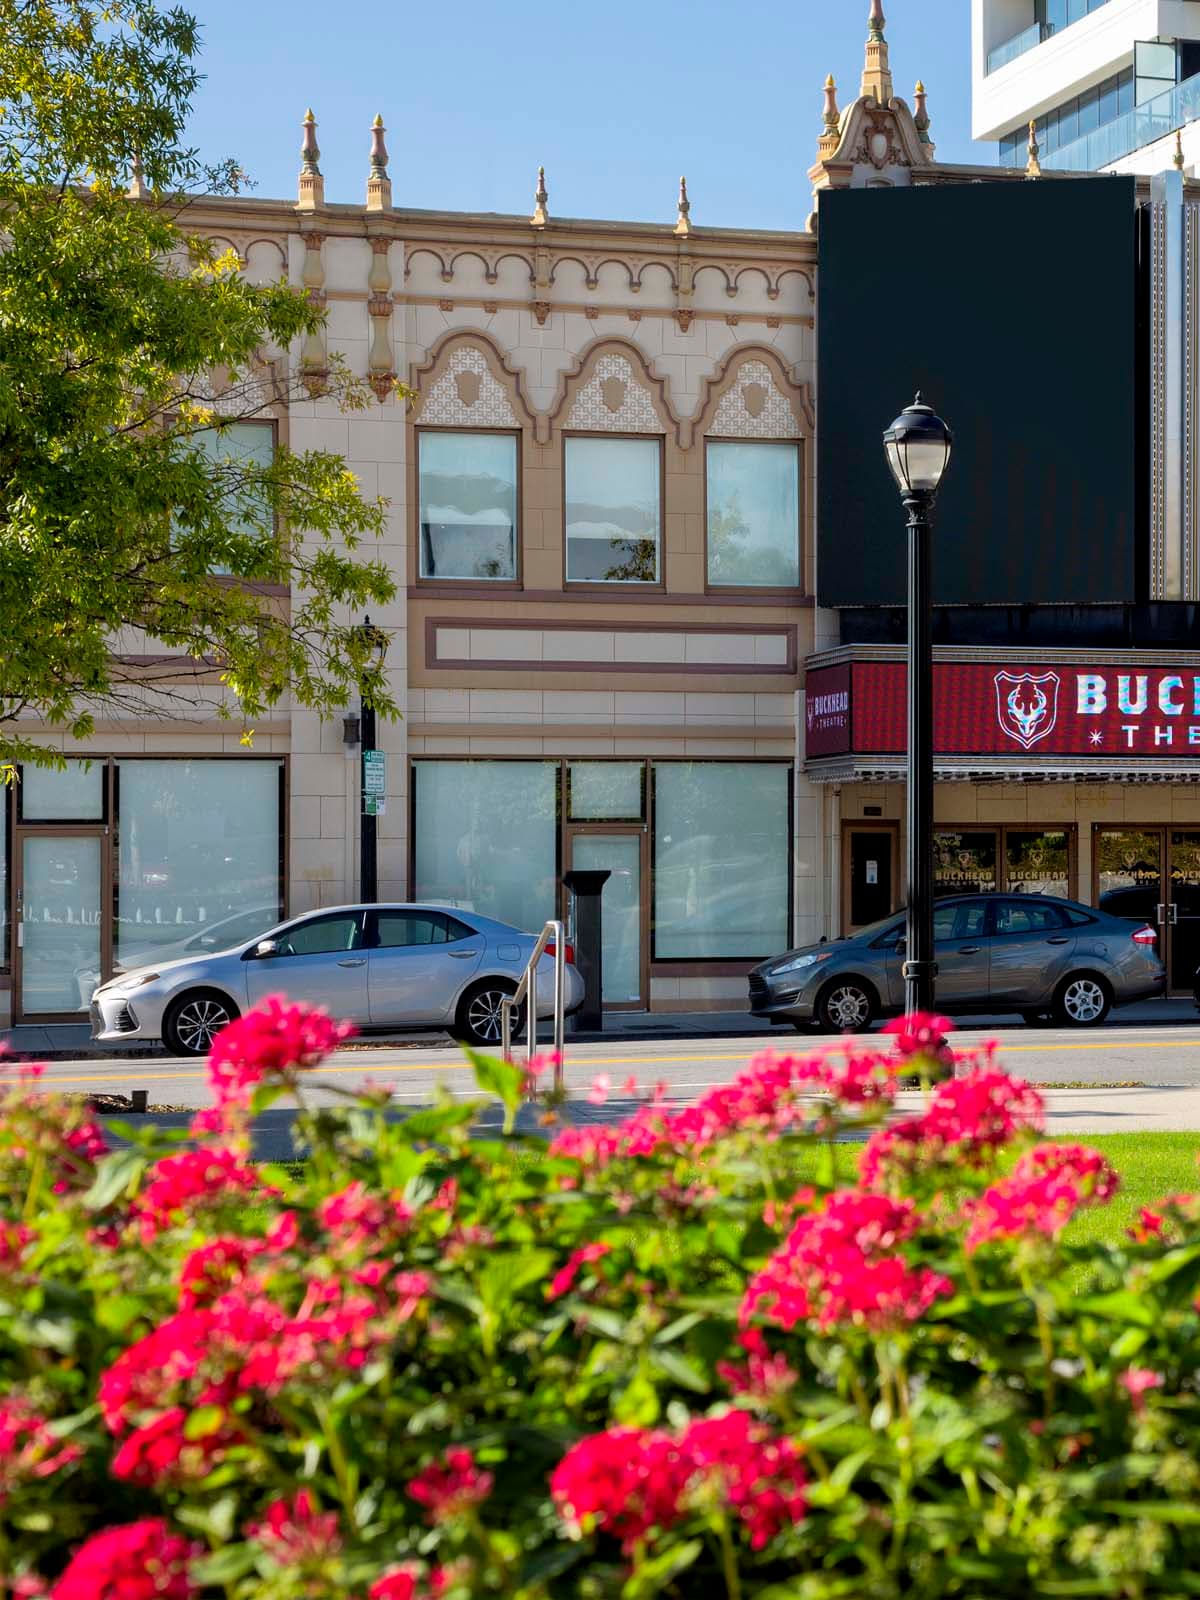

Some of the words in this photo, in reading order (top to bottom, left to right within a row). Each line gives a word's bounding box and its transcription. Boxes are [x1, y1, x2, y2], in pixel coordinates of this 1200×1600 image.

[815, 691, 848, 716] BUCKHEAD
[935, 871, 993, 881] BUCKHEAD
[1009, 871, 1067, 880] BUCKHEAD
